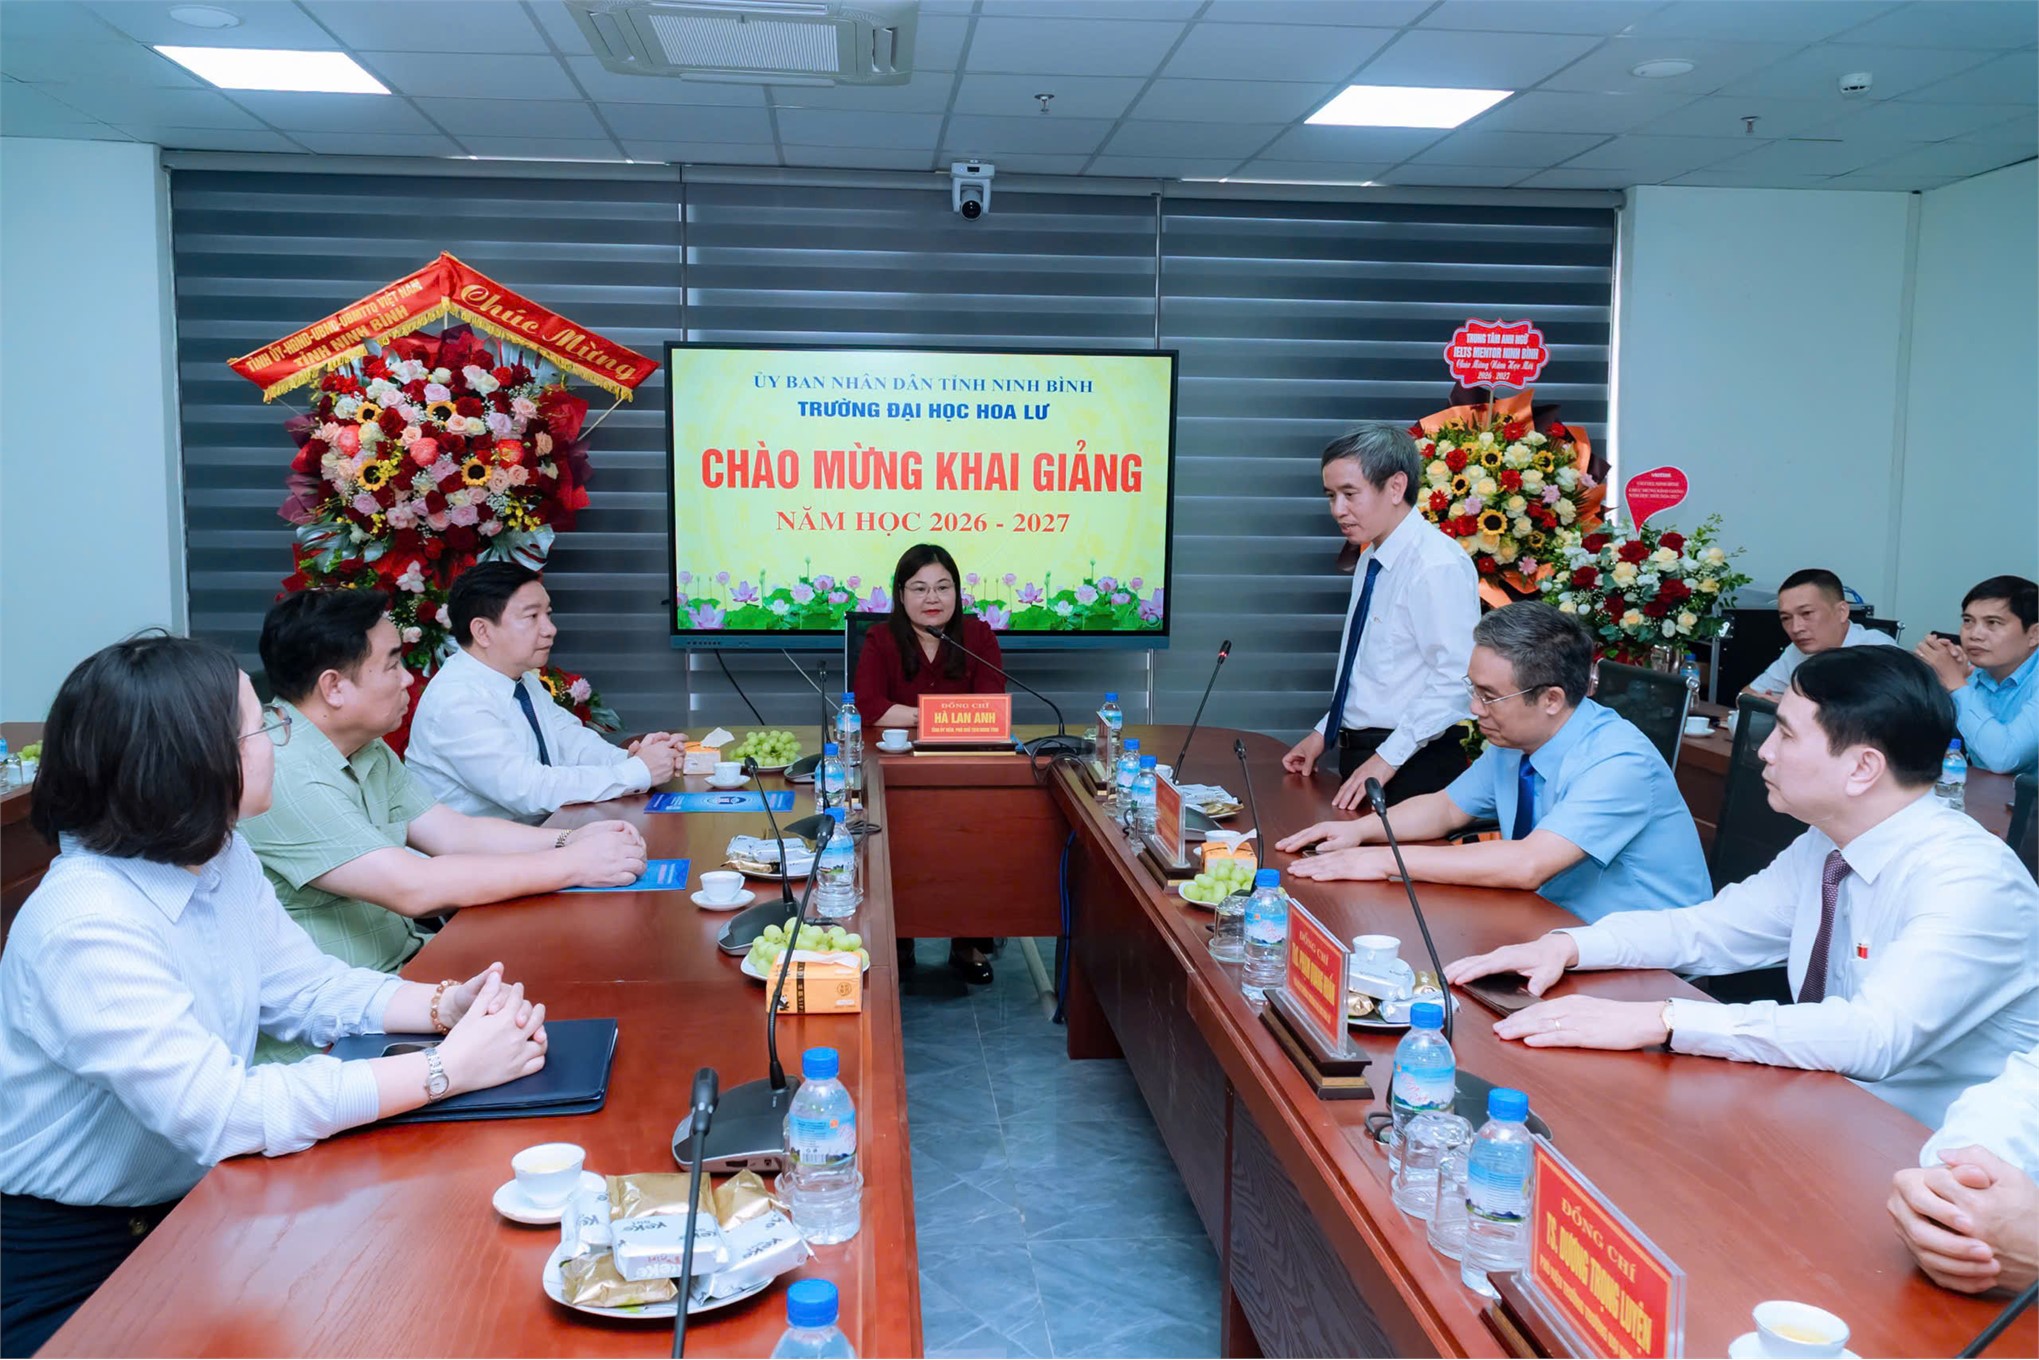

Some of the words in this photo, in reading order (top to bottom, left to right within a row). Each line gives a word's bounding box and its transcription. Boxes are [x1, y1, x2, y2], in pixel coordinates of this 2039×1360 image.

[330, 325, 371, 351] NINH
[369, 304, 410, 331] BÌNH
[461, 284, 540, 335] Chúc
[541, 329, 637, 380] Mừng
[1453, 346, 1472, 358] IELTS
[754, 370, 780, 388] ỦY
[786, 375, 825, 389] BAN
[831, 372, 886, 391] NHÂN
[893, 373, 933, 391] DÂN
[938, 374, 989, 392] TỈNH
[992, 378, 1040, 392] NINH
[1047, 376, 1093, 393] BÌNH
[797, 398, 880, 418] TRƯỜNG
[887, 402, 921, 421] ĐẠI
[928, 403, 969, 422] HỌC
[976, 403, 1017, 420] HOA
[1024, 403, 1050, 420] LƯ
[701, 440, 799, 490] CHÀO
[814, 442, 923, 491] MỪNG
[936, 451, 1019, 492] KHAI
[1032, 439, 1142, 493] GIẢNG
[776, 506, 845, 532] NĂM
[854, 511, 921, 536] HỌC
[929, 512, 987, 532] 2026
[1013, 512, 1070, 533] 2027
[934, 710, 949, 724] HÀ
[951, 711, 971, 724] LAN
[973, 711, 996, 724] ANH
[1561, 1197, 1604, 1250] ĐỒNG
[1606, 1245, 1636, 1283] CHÍ
